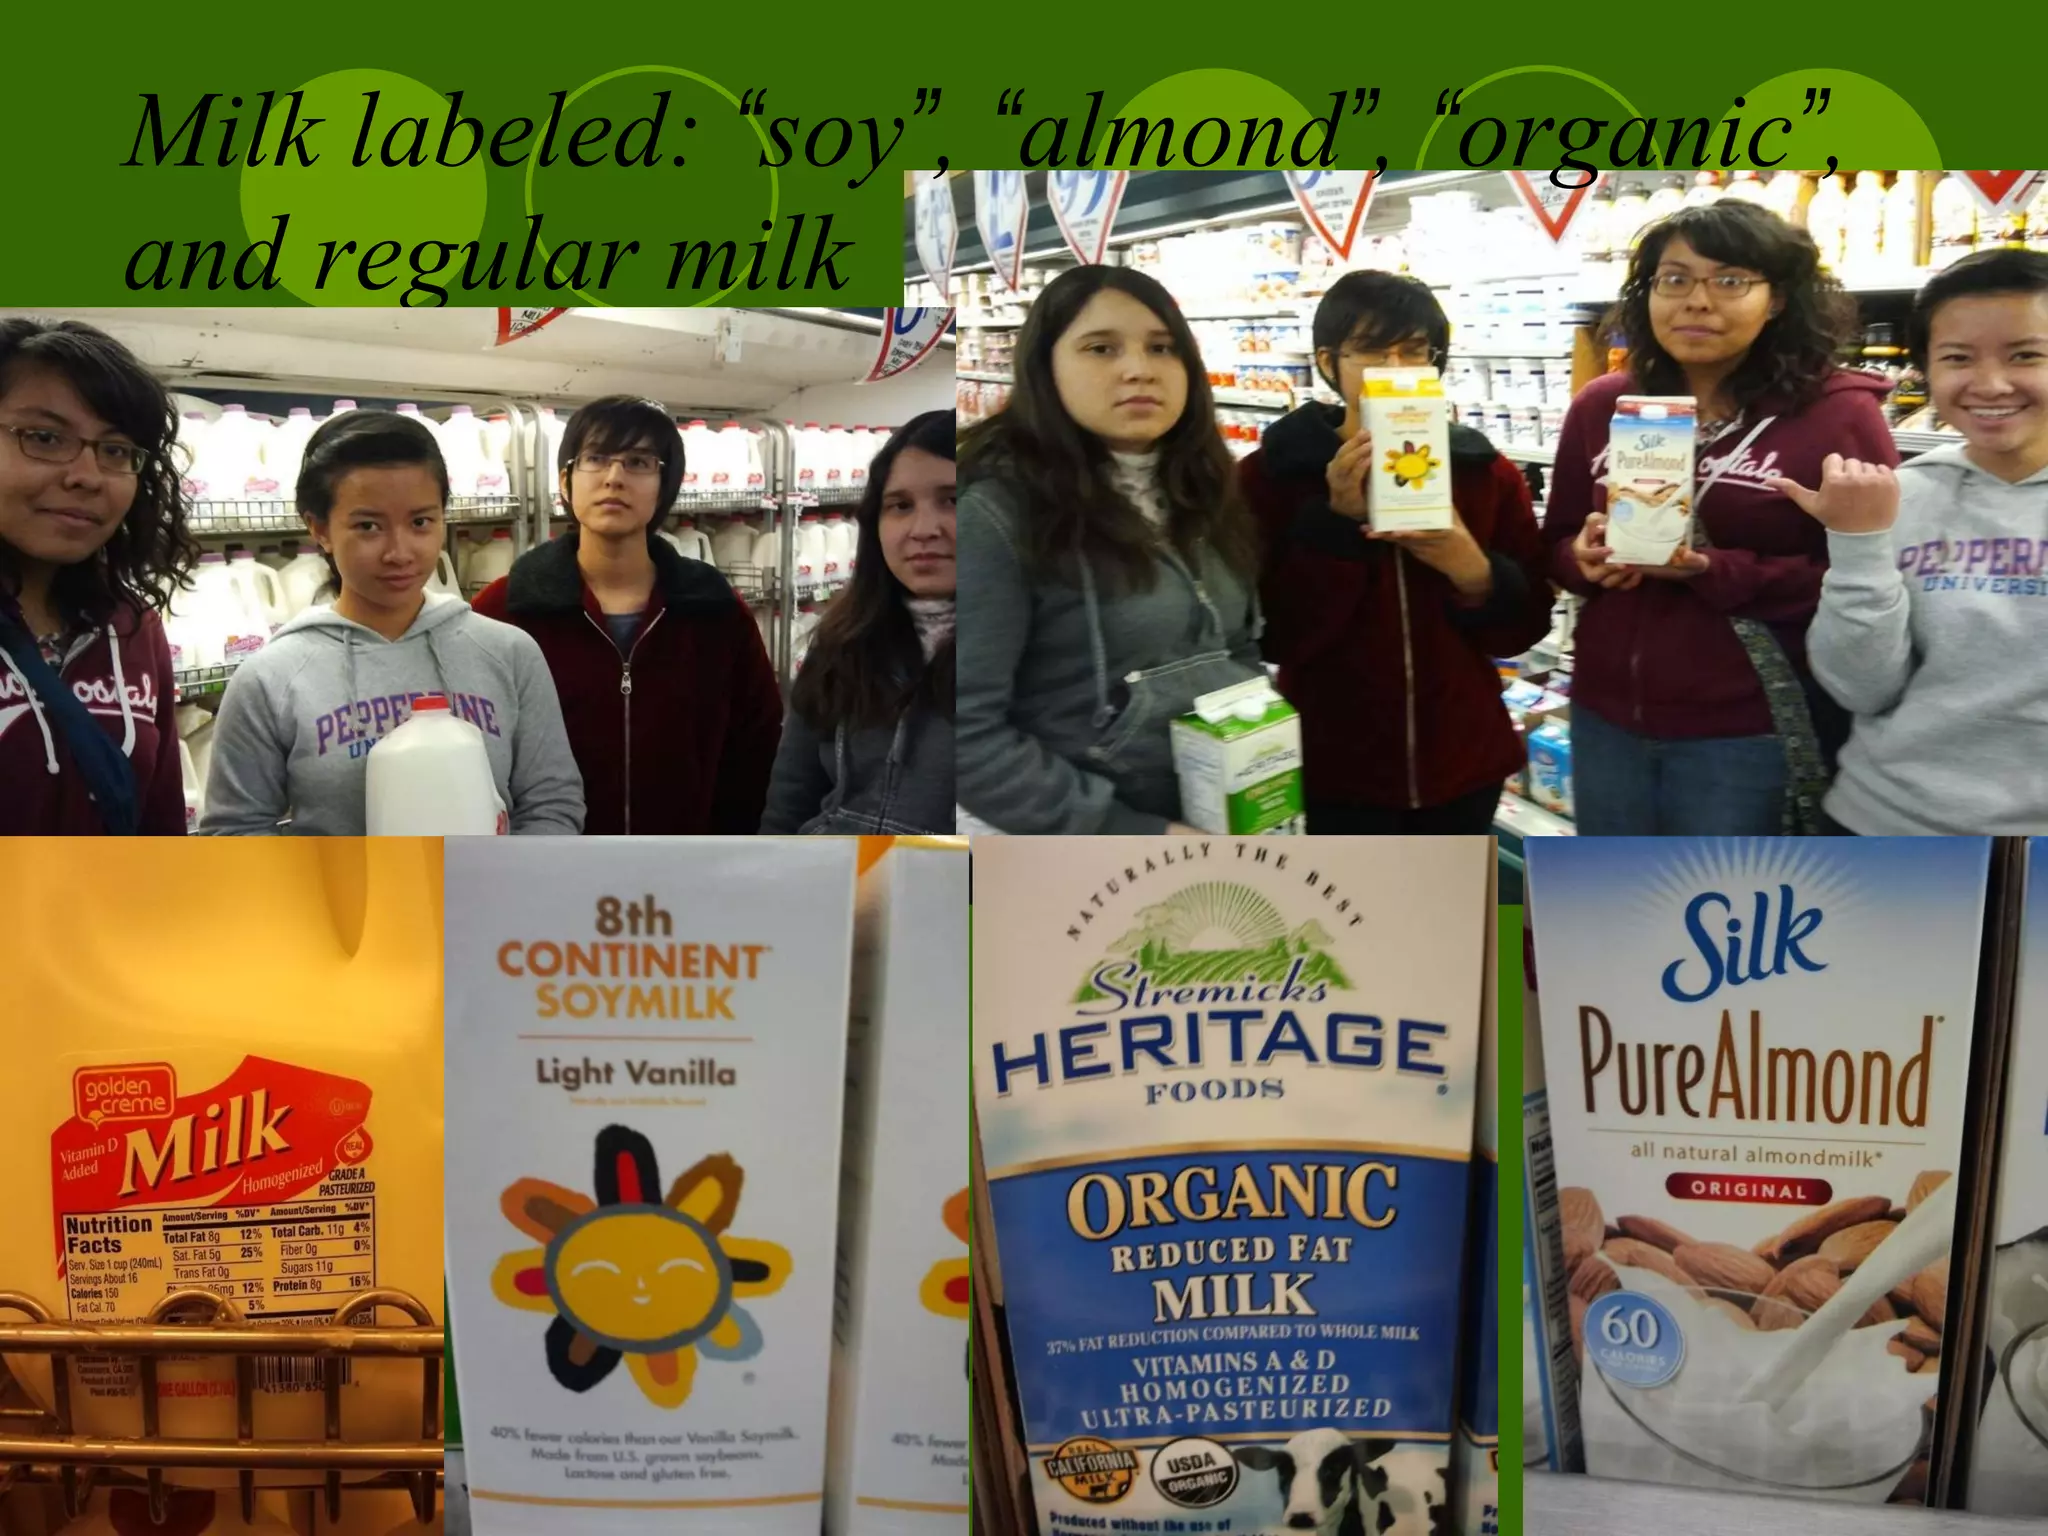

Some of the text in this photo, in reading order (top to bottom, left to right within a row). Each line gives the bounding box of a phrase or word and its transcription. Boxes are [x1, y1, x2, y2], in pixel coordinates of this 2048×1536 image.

[1633, 432, 1666, 451] Silk
[1896, 537, 2048, 577] PEPPER
[1066, 842, 1364, 942] NATURALLY THE BEST
[595, 895, 673, 937] 8th
[1661, 884, 1829, 1002] Silk
[497, 942, 764, 979] CONTINENT
[1076, 957, 1327, 1016] Stremicks
[536, 984, 735, 1020] SOYMILK
[992, 1009, 1449, 1098] HERITAGE
[536, 1058, 736, 1091] Light Vanilla
[1579, 1005, 1934, 1127] PureAlmond
[85, 1076, 150, 1102] golden
[1146, 1077, 1286, 1106] FOODS
[60, 1137, 119, 1165] Vitamin D
[117, 1088, 294, 1199] Milk
[346, 1141, 362, 1152] REAL
[1631, 1141, 1655, 1158] all
[1663, 1143, 1738, 1162] natural
[61, 1163, 98, 1182] Added
[243, 1157, 323, 1195] Homogenized
[329, 1167, 365, 1181] GRADE A
[319, 1182, 375, 1196] PASTEURIZED
[1691, 1180, 1807, 1200] ORIGINAL
[270, 1205, 336, 1217] Amount/Serving
[1066, 1161, 1399, 1241] ORGANIC
[66, 1216, 152, 1234] Nutrition
[162, 1211, 228, 1222] Amount/Serving
[164, 1228, 262, 1245] Total Fat 8g 12%
[272, 1221, 370, 1238] Total Carb. 11g 4%
[68, 1237, 122, 1254] Facts
[173, 1247, 263, 1263] Sat. Fat 5g 25%
[280, 1239, 370, 1256] Fiber 0g 0%
[1111, 1235, 1352, 1273] REDUCED FAT
[69, 1260, 87, 1271] Serv.
[89, 1259, 105, 1270] Size
[113, 1260, 128, 1273] cup
[130, 1257, 162, 1271] (240mL)
[174, 1266, 230, 1280] Trans Fat 0g
[281, 1260, 333, 1274] Sugars 11g
[70, 1273, 138, 1287] Servings About 16
[242, 1282, 264, 1294] 12%
[273, 1276, 371, 1292] Protein 8g 16%
[71, 1288, 119, 1299] Calories 150
[1152, 1272, 1317, 1324] MILK
[77, 1303, 88, 1313] Fat
[106, 1302, 116, 1313] 70
[248, 1300, 265, 1310] 5%
[1601, 1305, 1659, 1348] 60
[1047, 1324, 1421, 1355] 37% FAT REDUCTION COMPARED TO WHOLE MILK
[1132, 1349, 1336, 1379] VITAMINS A & D
[1119, 1373, 1351, 1404] HOMOGENIZED
[1081, 1398, 1392, 1430] ULTRA-PASTEURIZED
[490, 1426, 521, 1440] 40%
[525, 1428, 562, 1443] fewer
[568, 1432, 620, 1445] calories
[625, 1432, 656, 1445] than
[659, 1435, 682, 1446] our
[687, 1430, 736, 1445] Vanilla
[531, 1448, 571, 1461] Made
[575, 1449, 608, 1463] from
[612, 1451, 640, 1463] U.S.
[645, 1452, 691, 1466] grown
[1068, 1443, 1100, 1455] REAL
[1048, 1453, 1135, 1477] CALIFORNIA
[1167, 1451, 1218, 1474] USDA
[564, 1466, 615, 1480] Lactose
[620, 1467, 648, 1480] and
[652, 1467, 695, 1484] gluten
[1075, 1473, 1117, 1486] MILK
[1168, 1471, 1229, 1494] ORGANIC
[1050, 1511, 1231, 1531] Produced without the use of
